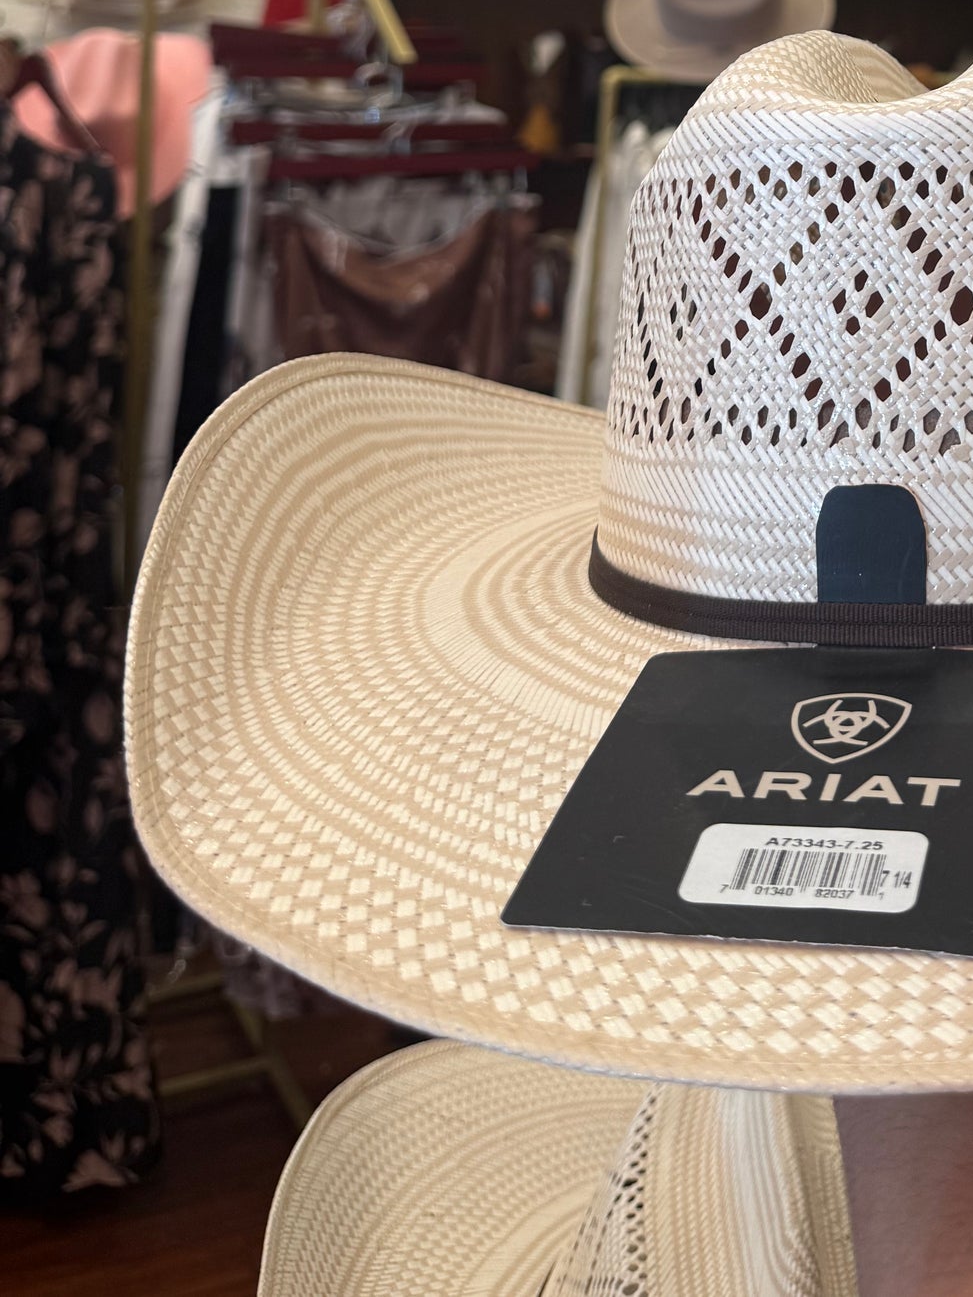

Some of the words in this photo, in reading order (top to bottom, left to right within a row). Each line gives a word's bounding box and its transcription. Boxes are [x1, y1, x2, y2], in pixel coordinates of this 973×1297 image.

[685, 769, 961, 806] ARIAT
[765, 837, 884, 850] A73343-7.25
[880, 870, 890, 887] 7
[719, 884, 729, 893] 7
[754, 886, 794, 897] 01340
[815, 889, 855, 900] 82037
